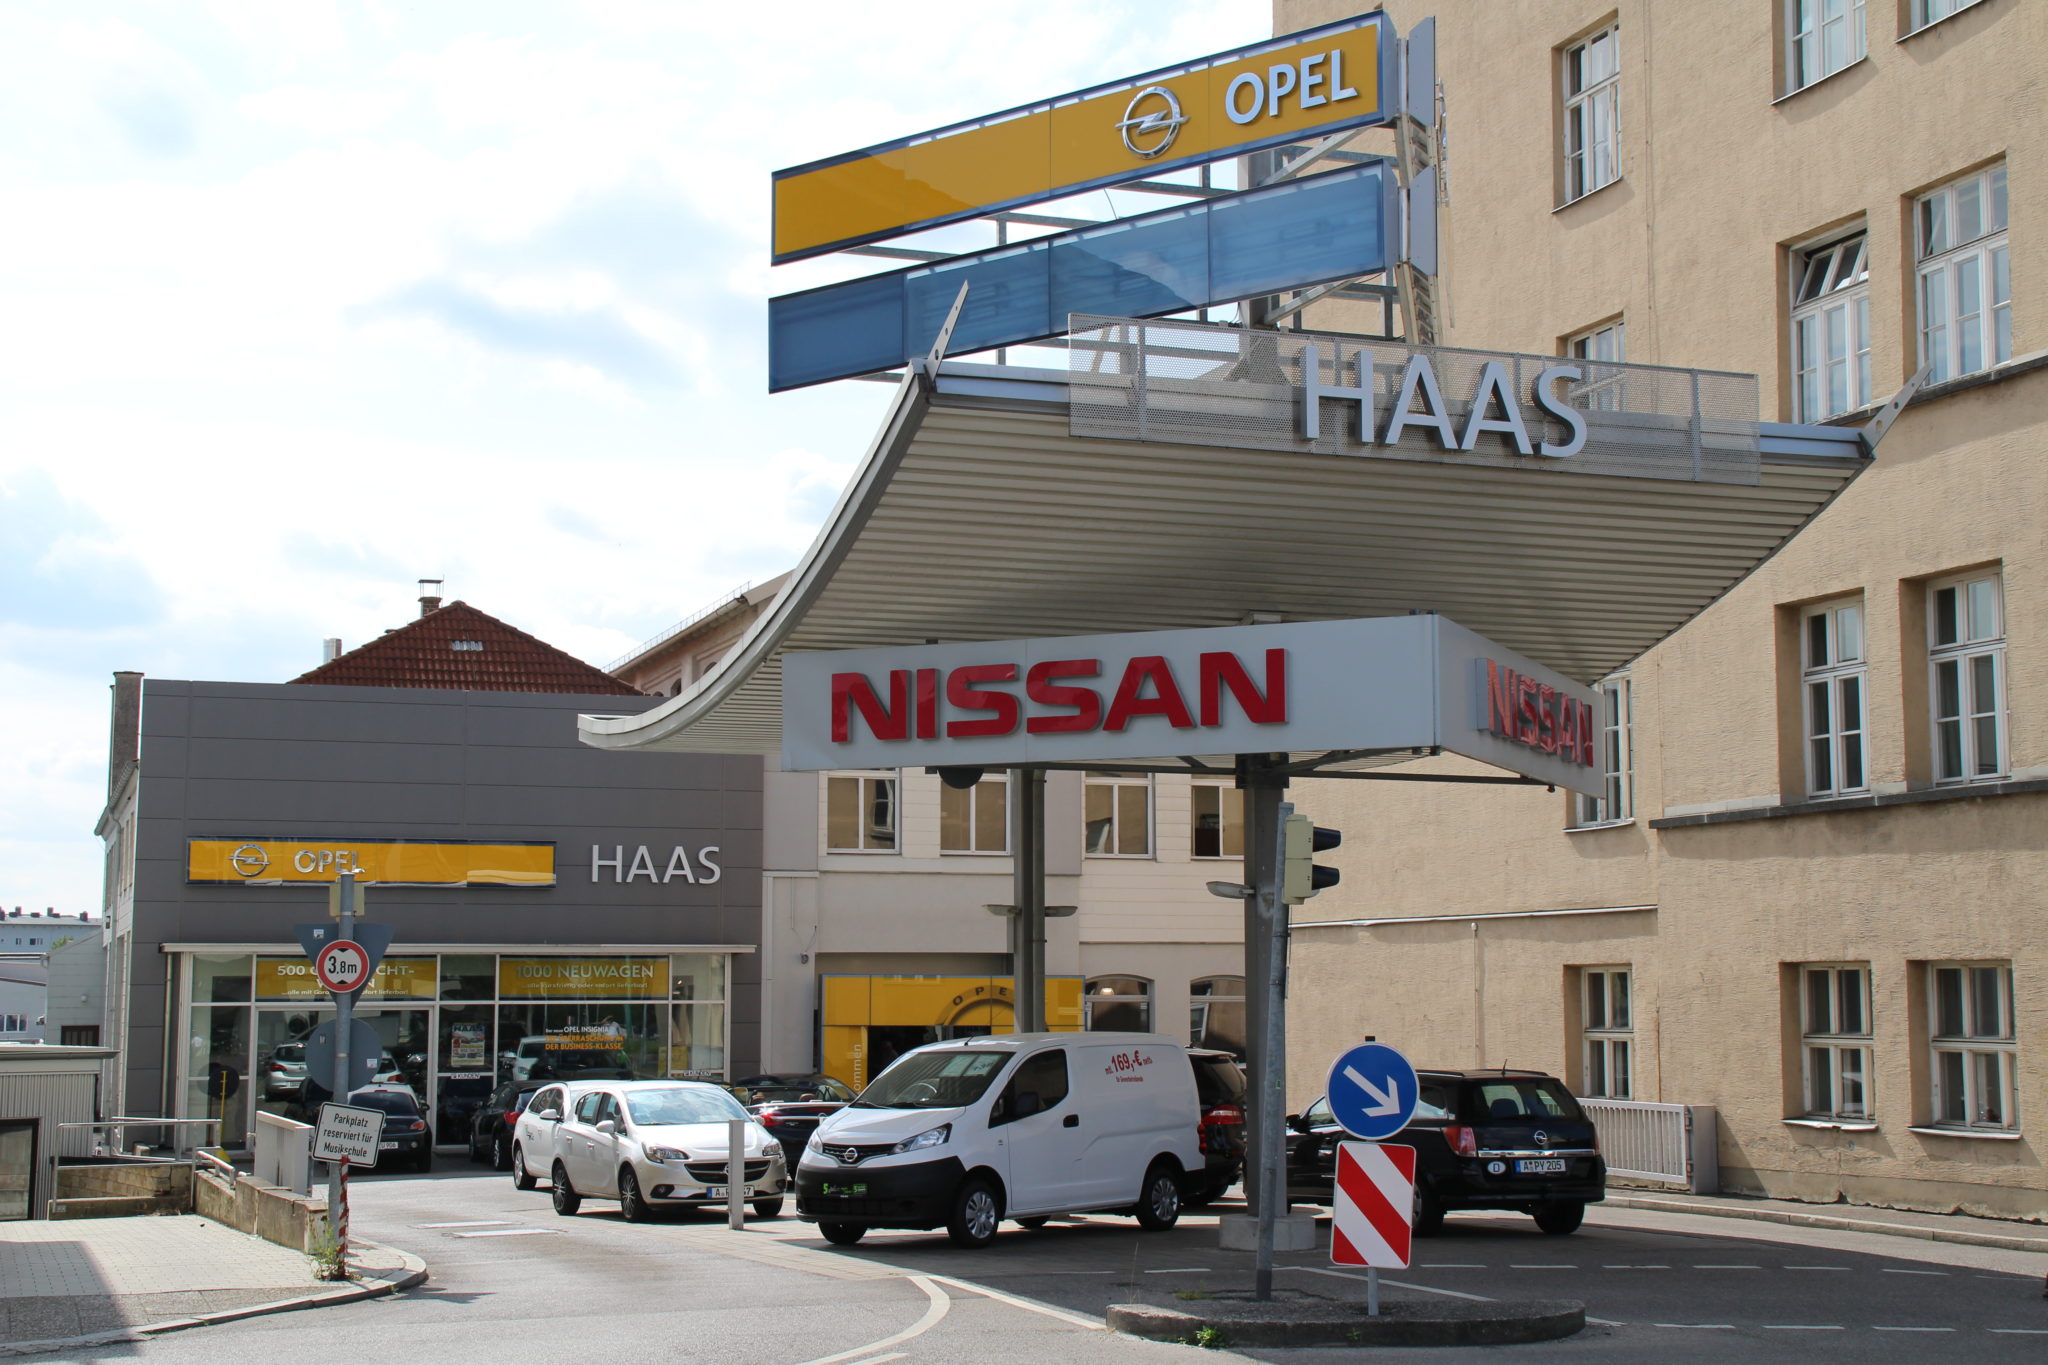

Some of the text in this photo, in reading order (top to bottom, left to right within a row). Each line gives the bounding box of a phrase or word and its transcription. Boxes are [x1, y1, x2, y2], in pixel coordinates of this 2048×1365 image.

[1225, 48, 1359, 126] OPEL
[1299, 344, 1588, 458] HAAS
[831, 647, 1290, 744] NISSAN
[1483, 657, 1594, 768] NISSAN
[294, 850, 366, 873] OPEL
[591, 844, 722, 885] HAAS
[277, 965, 306, 976] 500
[516, 965, 654, 978] 1000 NEUWAGEN
[334, 1113, 369, 1128] Parkplatz
[323, 1128, 373, 1143] reserviert für
[323, 1142, 368, 1158] Musikschule
[1493, 1163, 1500, 1173] D
